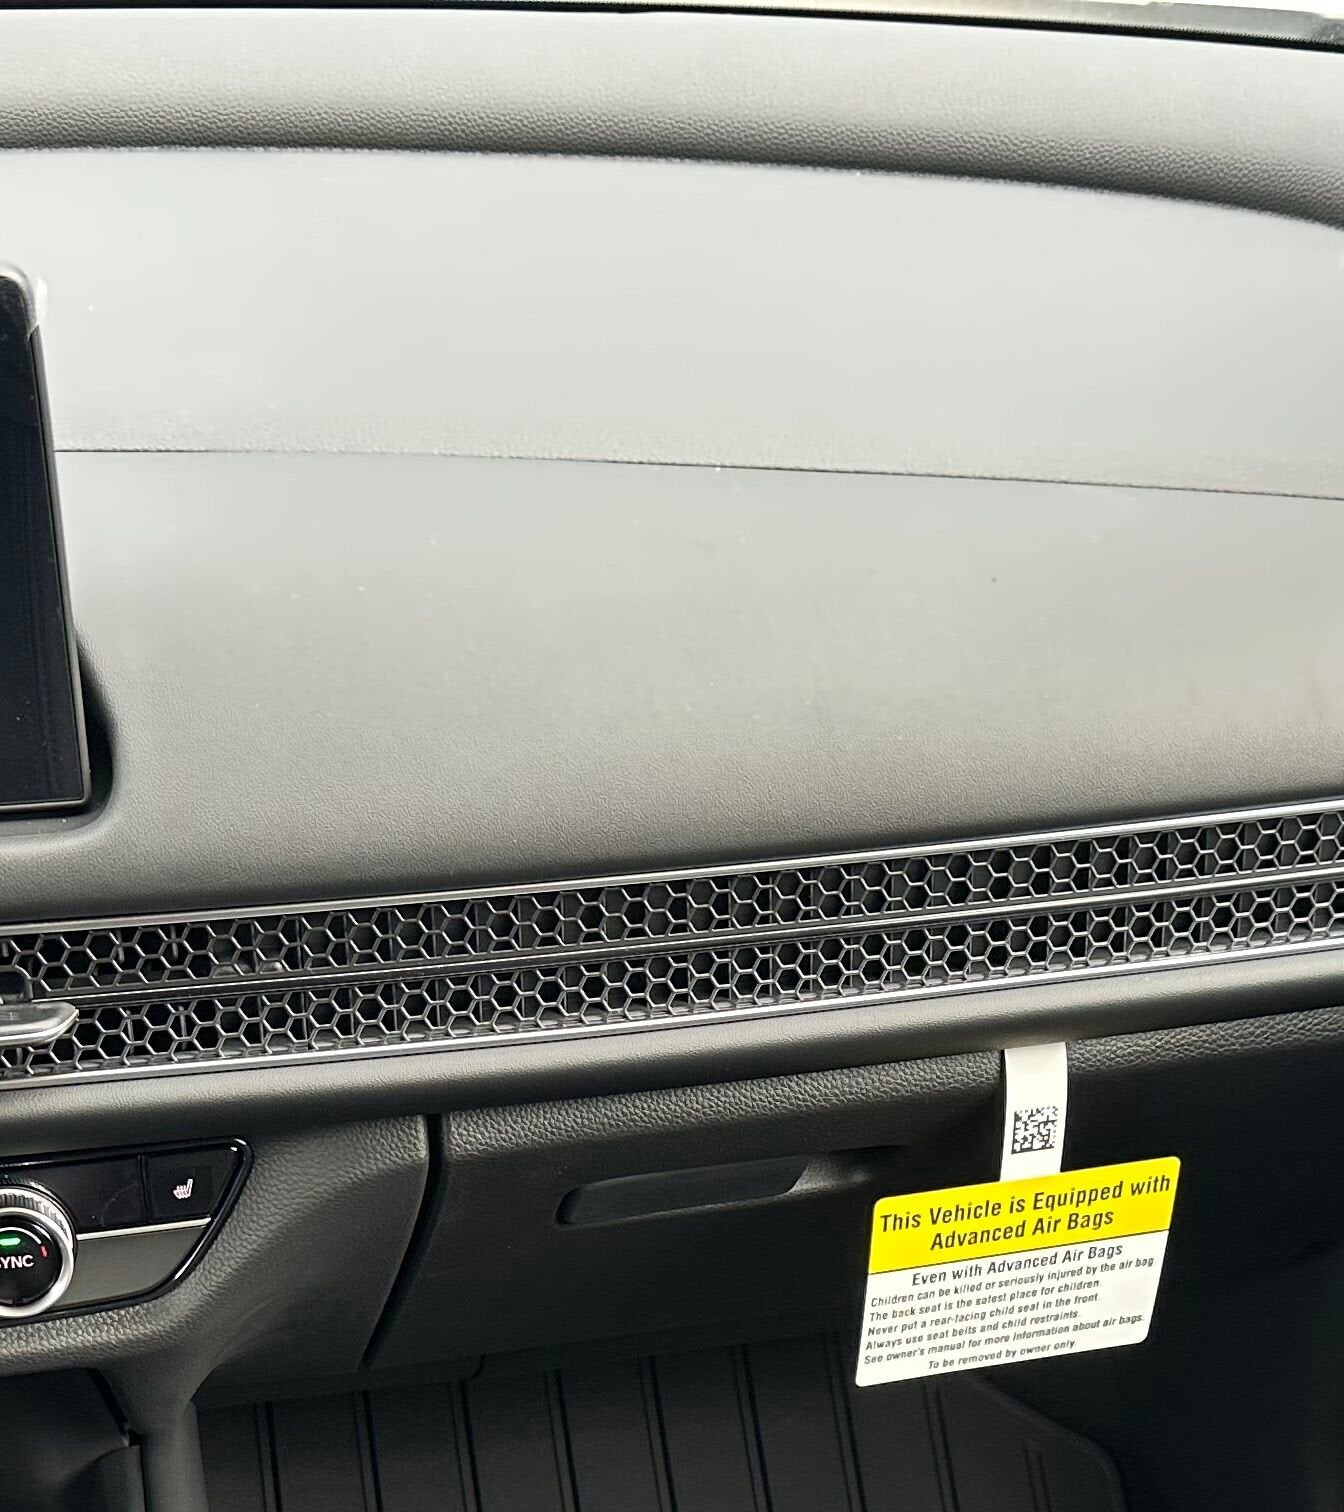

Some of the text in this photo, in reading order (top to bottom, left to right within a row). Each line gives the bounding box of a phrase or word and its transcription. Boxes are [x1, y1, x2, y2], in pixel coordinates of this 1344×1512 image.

[880, 1174, 1171, 1233] This Vehicle is Equipped with
[929, 1210, 1115, 1251] Advanced Air Bags
[871, 1293, 914, 1308] Children
[917, 1291, 935, 1301] can
[938, 1287, 951, 1297] be
[954, 1282, 982, 1295] killed
[984, 1280, 996, 1290] or
[998, 1273, 1045, 1290] seriously
[1047, 1266, 1083, 1281] injured
[1085, 1264, 1098, 1275] by
[1100, 1261, 1116, 1273] the
[1118, 1258, 1133, 1270] air
[911, 1244, 1124, 1287] Even with Advanced Air Bags
[867, 1325, 899, 1337] Never
[900, 1320, 918, 1334] put
[929, 1310, 987, 1328] rear-facing
[989, 1305, 1015, 1318] child
[1017, 1301, 1040, 1313] seat
[1042, 1299, 1052, 1309] in
[1055, 1296, 1071, 1307] the
[869, 1311, 888, 1322] The
[891, 1306, 916, 1319] back
[918, 1303, 941, 1315] seat
[943, 1301, 953, 1311] is
[956, 1297, 972, 1308] the
[975, 1292, 1007, 1306] safest
[1009, 1289, 1038, 1303] place
[1040, 1285, 1055, 1297] for
[864, 1354, 884, 1365] See
[886, 1347, 925, 1362] owner's
[927, 1340, 966, 1355] manual
[967, 1338, 982, 1349] for
[984, 1335, 1011, 1346] more
[1012, 1325, 1070, 1342] information
[1072, 1319, 1101, 1332] about
[1102, 1316, 1117, 1328] air
[865, 1336, 903, 1351] Always
[905, 1335, 924, 1345] use
[926, 1329, 949, 1341] seat
[951, 1325, 977, 1337] belts
[979, 1321, 1000, 1333] and
[1001, 1316, 1027, 1329] child
[928, 1360, 940, 1370] To
[942, 1358, 955, 1368] be
[957, 1350, 1003, 1366] removed
[1005, 1348, 1018, 1360] by
[1019, 1343, 1052, 1356] owner
